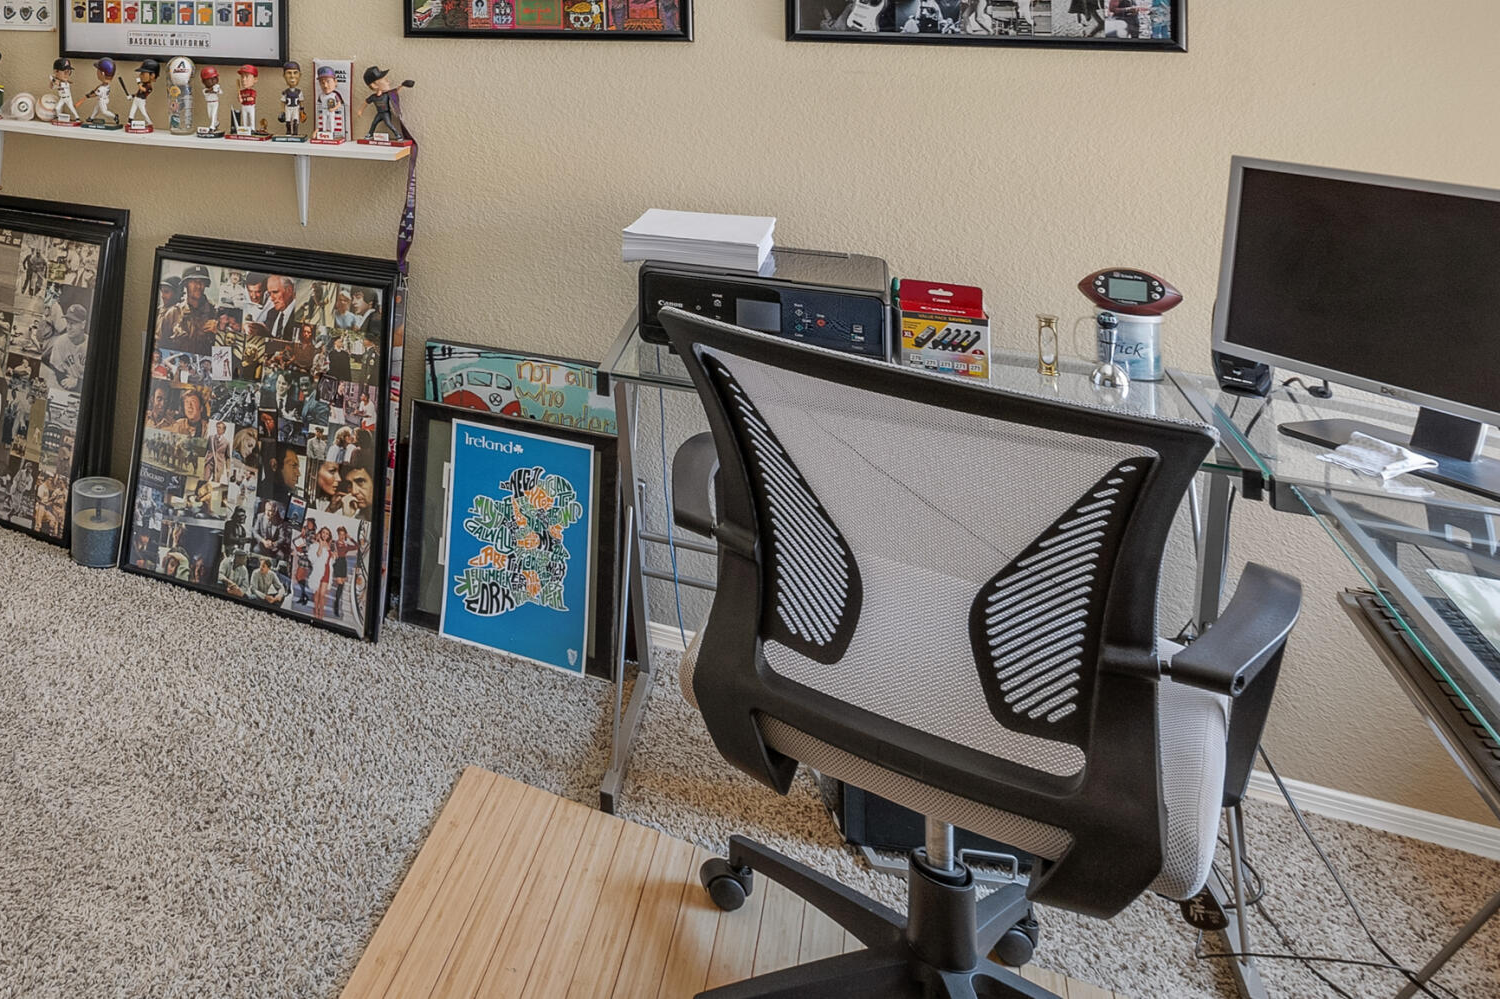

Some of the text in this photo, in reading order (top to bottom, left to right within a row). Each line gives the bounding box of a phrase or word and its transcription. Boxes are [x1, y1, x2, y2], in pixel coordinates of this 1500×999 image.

[129, 37, 210, 47] BASEBALL UNIFORMS
[564, 367, 593, 390] all
[514, 382, 565, 409] who
[464, 431, 513, 454] Ireland
[464, 581, 516, 615] CORK
